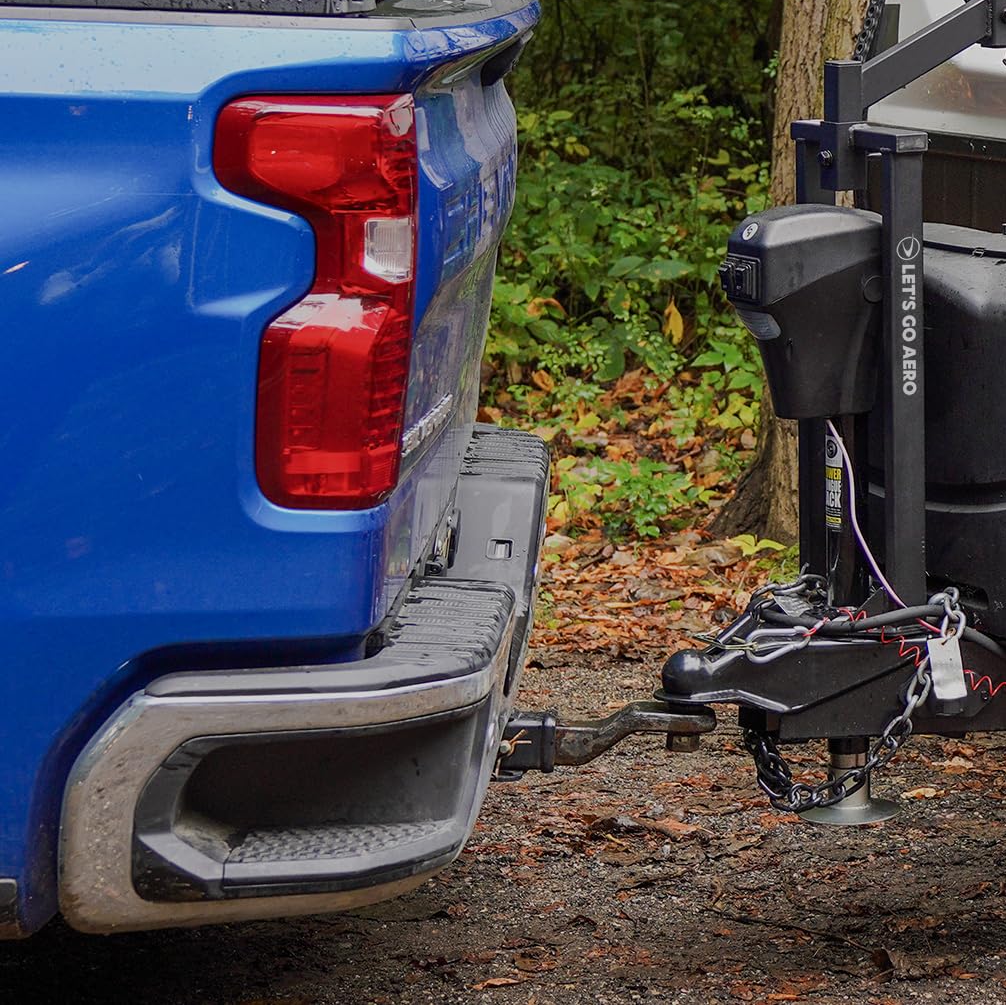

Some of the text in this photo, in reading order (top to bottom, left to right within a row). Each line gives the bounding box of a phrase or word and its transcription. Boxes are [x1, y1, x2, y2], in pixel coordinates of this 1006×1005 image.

[901, 264, 917, 396] LET'S GO AERO
